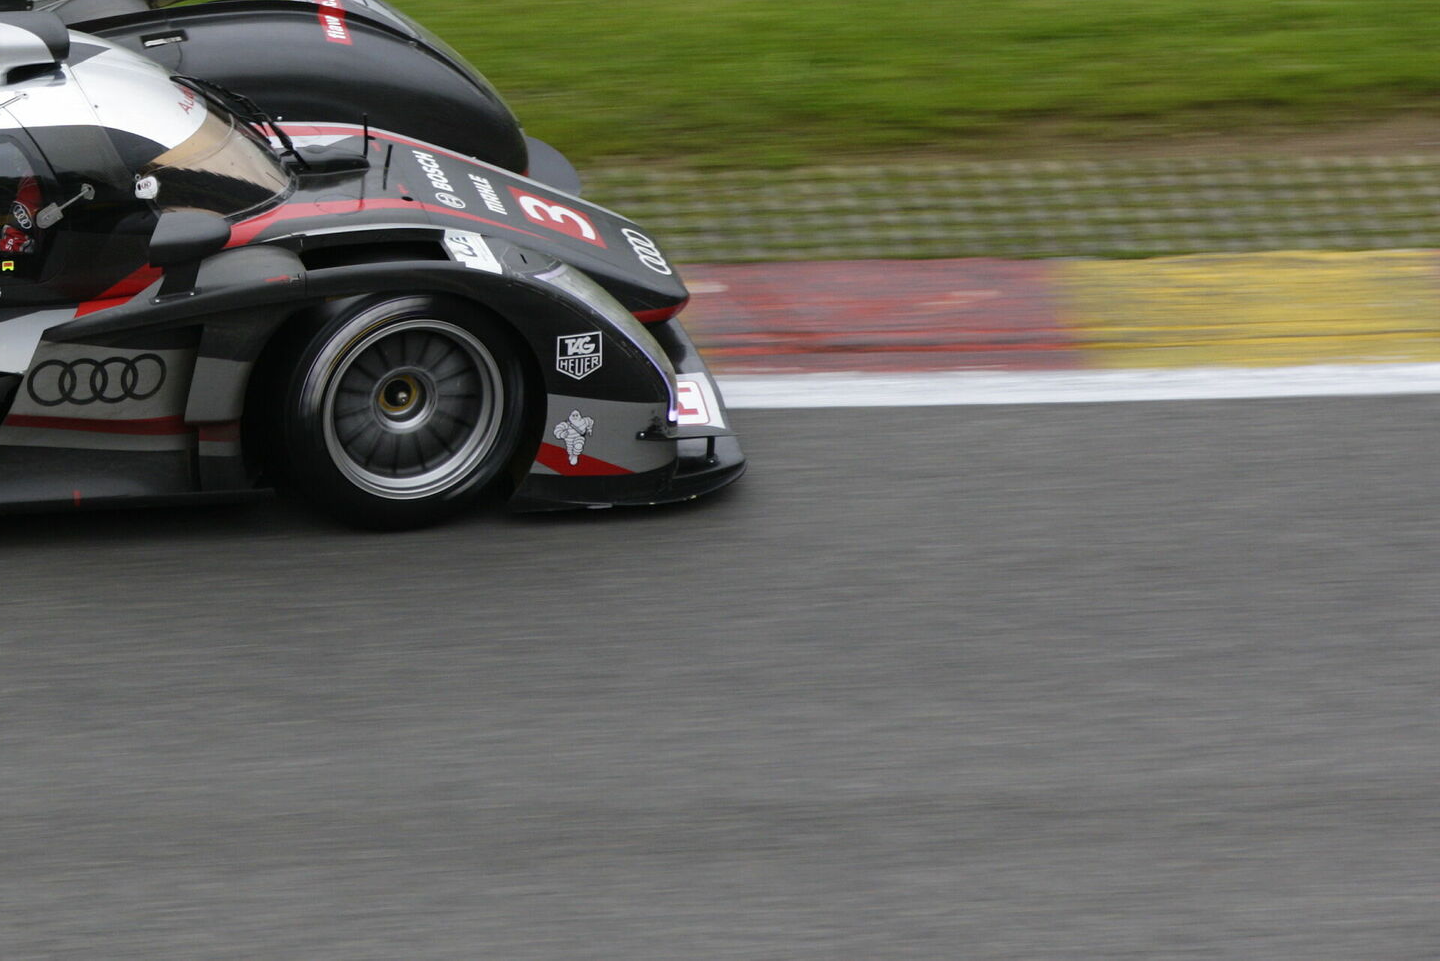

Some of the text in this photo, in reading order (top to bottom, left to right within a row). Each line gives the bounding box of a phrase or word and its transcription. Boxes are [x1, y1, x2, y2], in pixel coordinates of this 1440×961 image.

[412, 150, 454, 192] BOSCH
[519, 195, 596, 240] 3
[564, 335, 597, 356] TAG
[560, 356, 599, 376] HEUER
